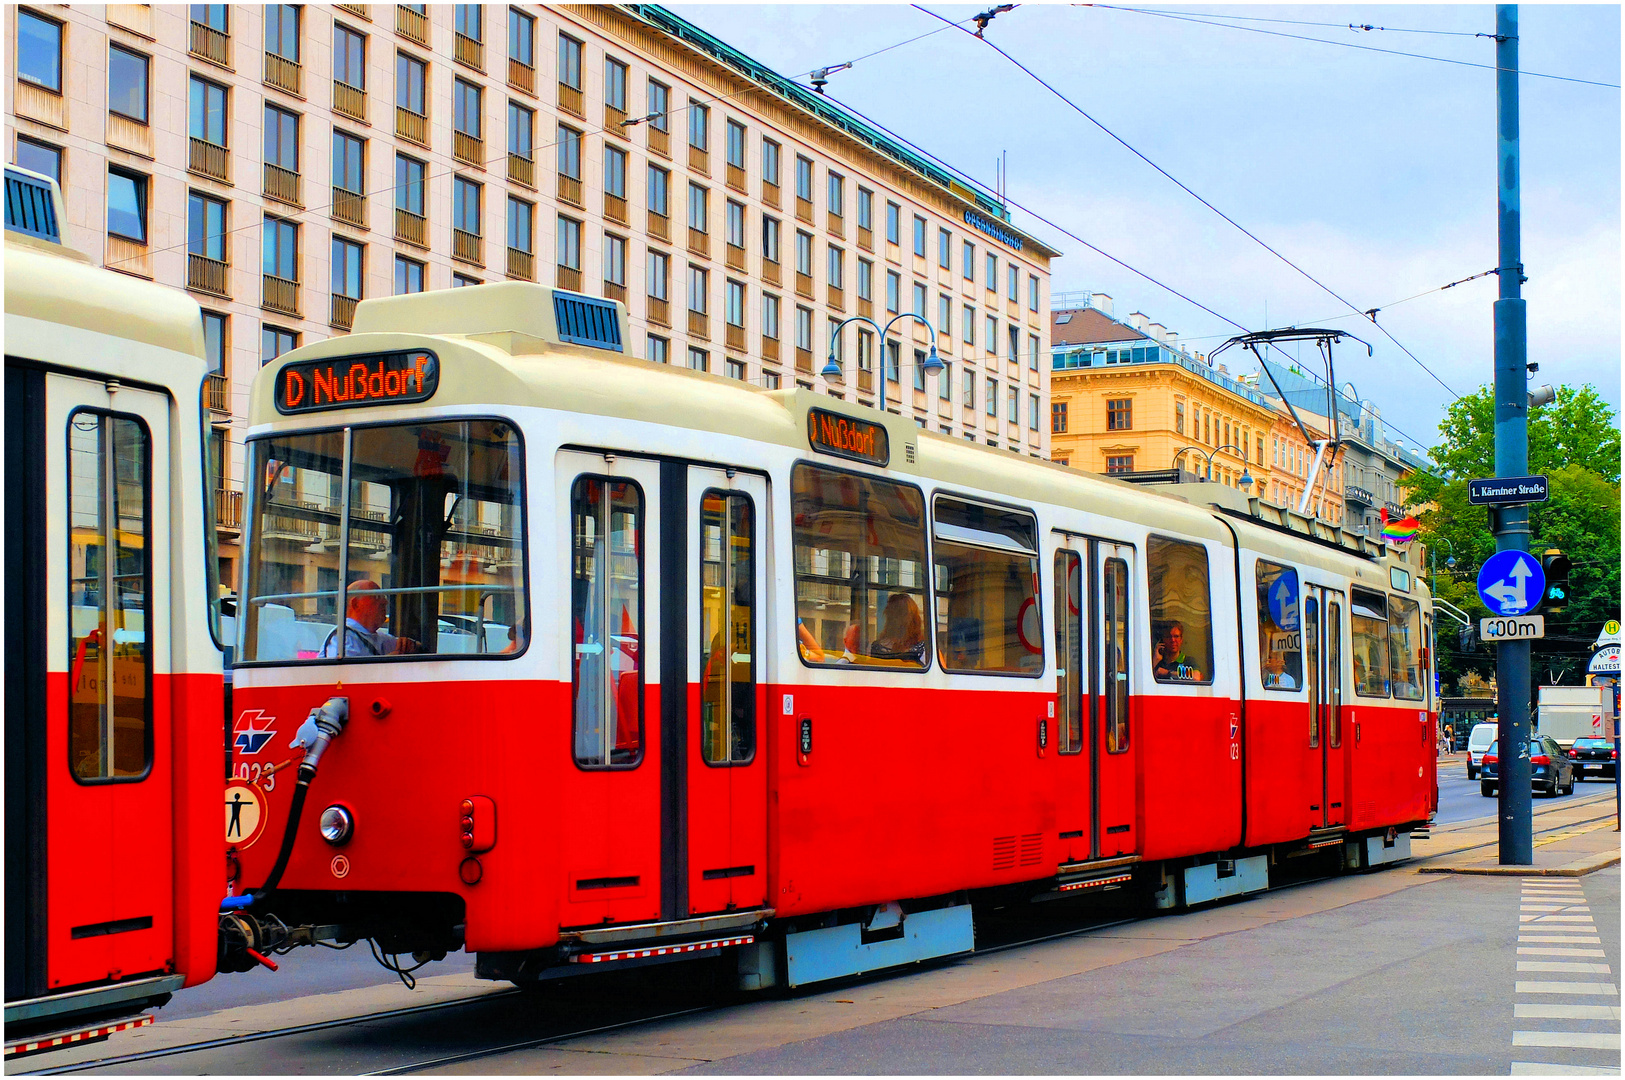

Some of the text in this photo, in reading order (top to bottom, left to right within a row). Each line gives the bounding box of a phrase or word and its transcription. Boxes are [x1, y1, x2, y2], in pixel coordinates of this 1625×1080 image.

[964, 210, 1024, 251] OPERNRINGHOF
[286, 356, 428, 407] D Nußdorf
[820, 414, 875, 456] Nußdorf
[1481, 486, 1518, 497] Kärntner
[1518, 483, 1545, 495] Straße
